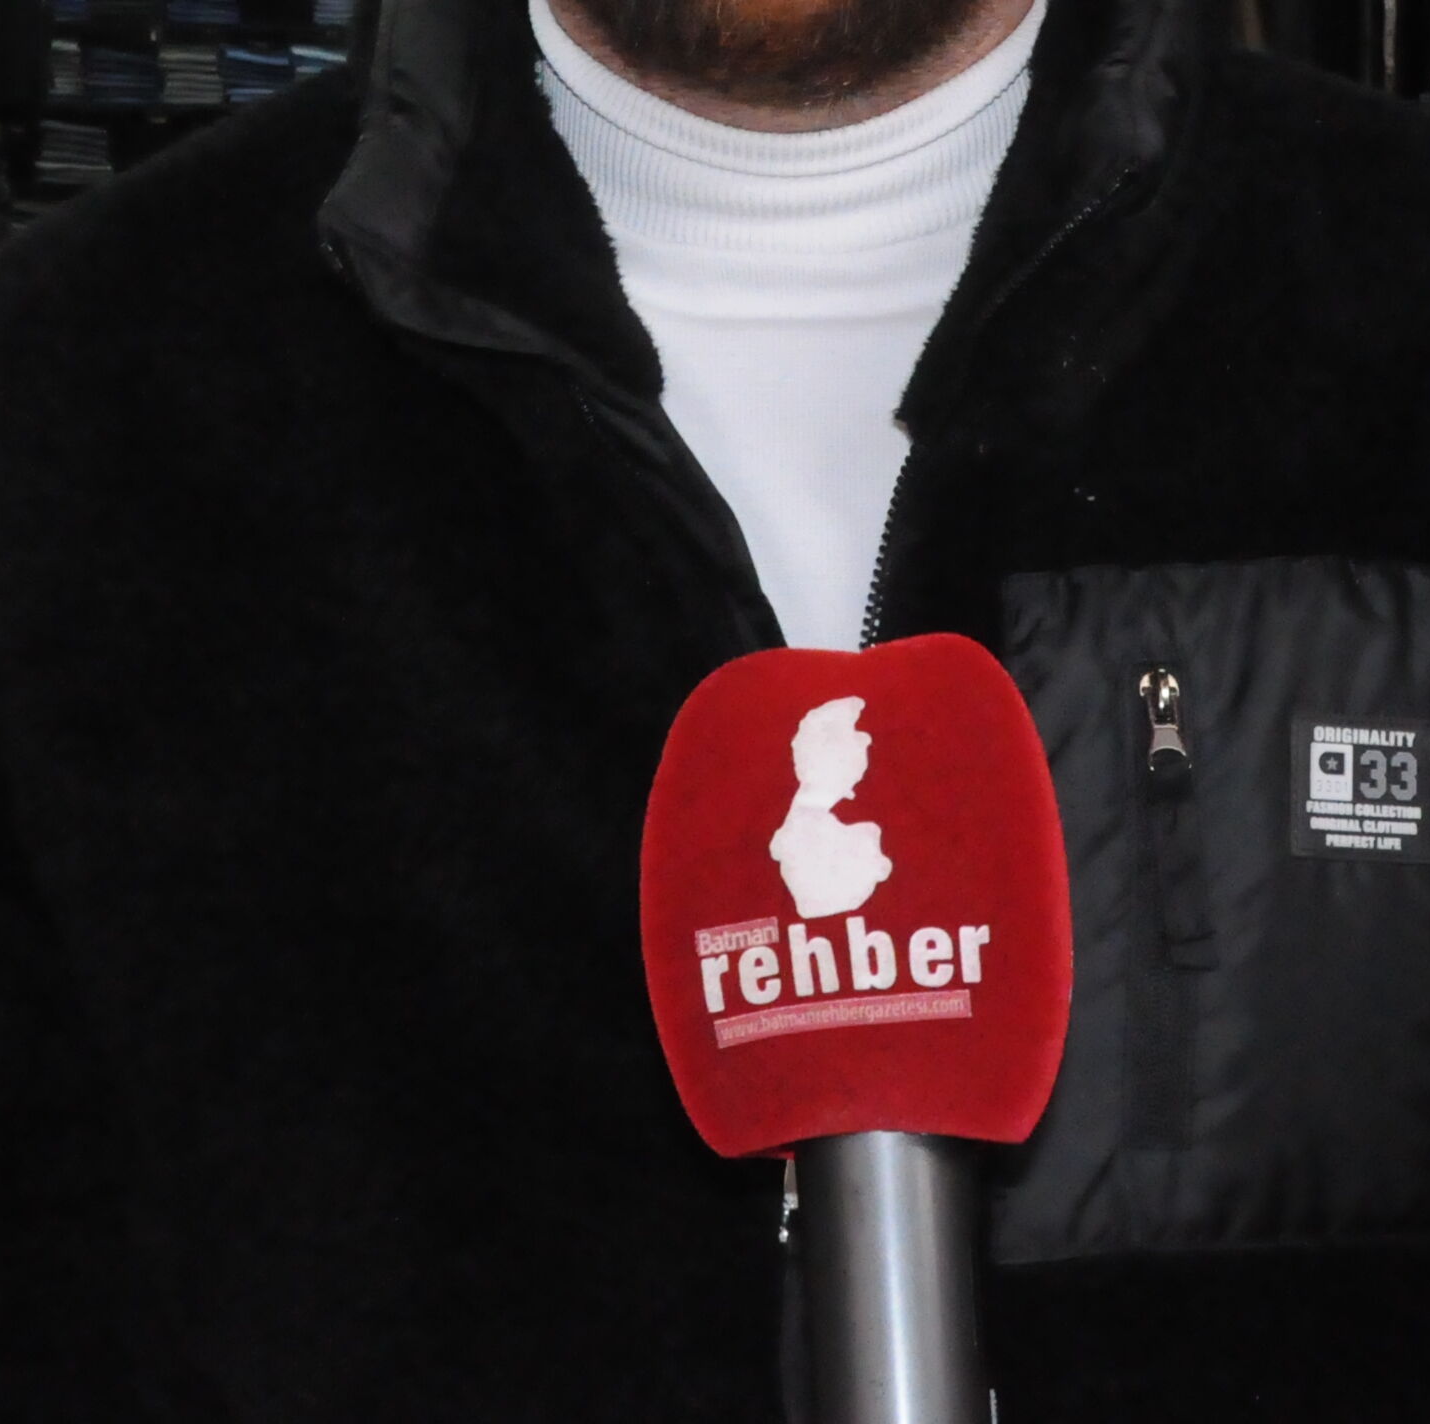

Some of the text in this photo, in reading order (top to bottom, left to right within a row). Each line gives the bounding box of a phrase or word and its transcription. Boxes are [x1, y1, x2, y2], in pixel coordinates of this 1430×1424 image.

[1313, 725, 1416, 748] ORIGINALITY
[1359, 749, 1418, 802] 33
[1306, 800, 1422, 820] FASHION COLLECTION
[1363, 819, 1418, 836] CLOTHING
[1326, 834, 1402, 850] PERFECT LIFE
[698, 925, 778, 955] Batman
[701, 915, 991, 1013] rehber
